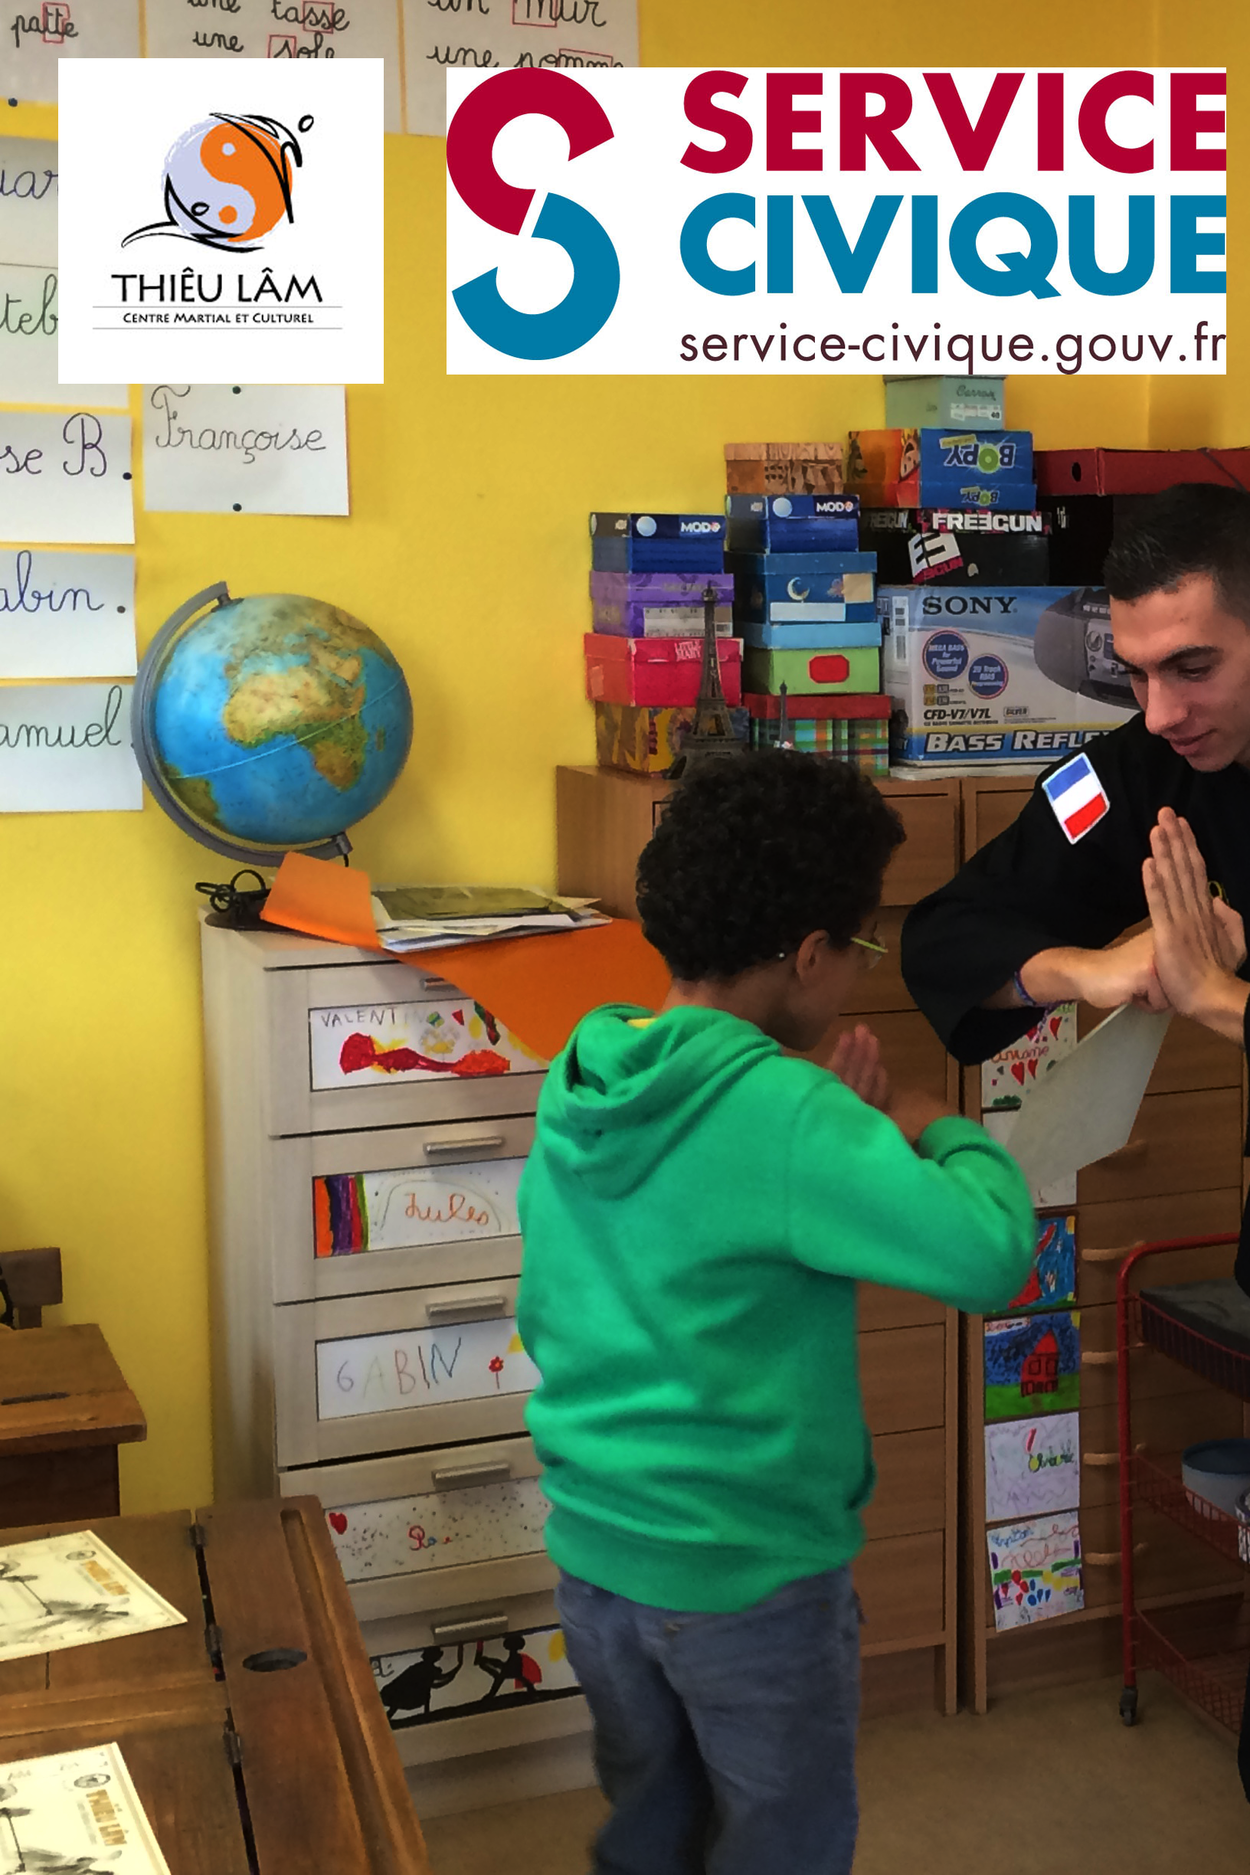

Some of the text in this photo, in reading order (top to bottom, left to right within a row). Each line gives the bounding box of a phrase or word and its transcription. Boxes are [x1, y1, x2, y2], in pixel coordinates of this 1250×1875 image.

[10, 5, 79, 48] patte
[192, 29, 244, 53] une
[151, 385, 326, 464] Françoise
[932, 511, 1043, 532] FREEGUN
[922, 595, 1018, 616] SONY
[923, 708, 992, 720] CFD-V7/V7L
[926, 732, 1004, 753] BASS
